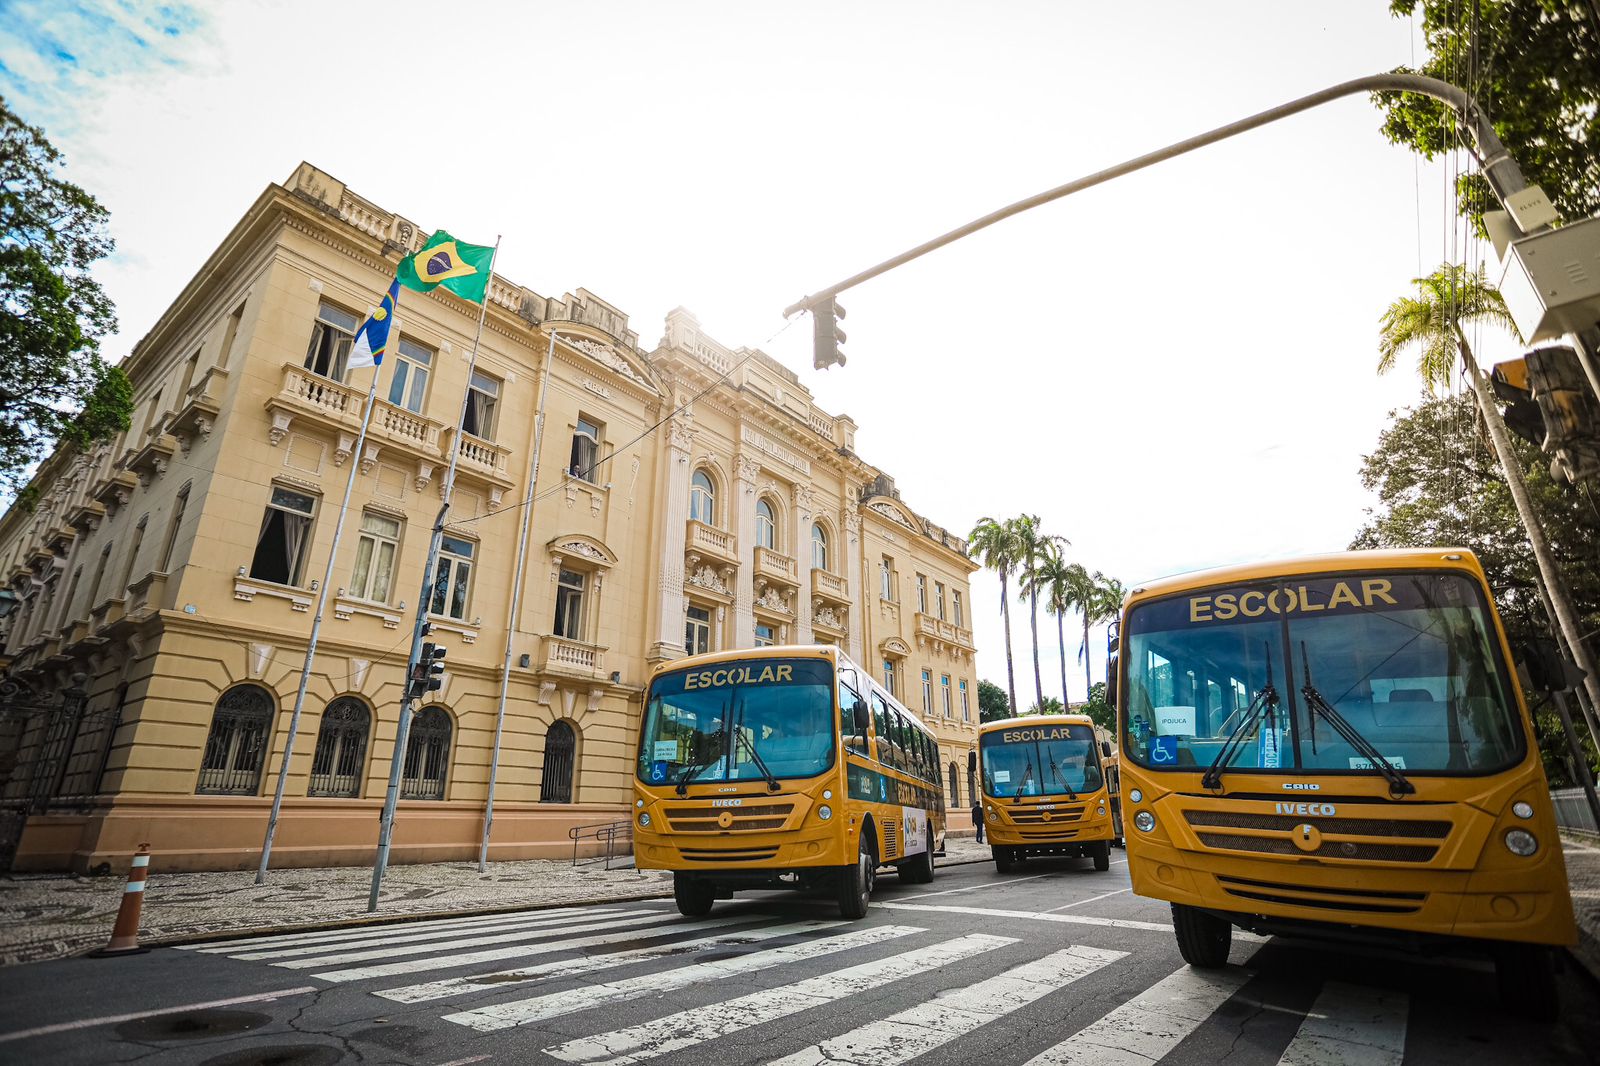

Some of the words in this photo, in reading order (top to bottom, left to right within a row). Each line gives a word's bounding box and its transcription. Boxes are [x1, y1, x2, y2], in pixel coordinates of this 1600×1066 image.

[1189, 578, 1398, 622] ESCOLAR
[684, 664, 793, 690] ESCOLAR
[1003, 728, 1071, 743] ESCOLAR
[712, 799, 742, 807] IVECO
[1275, 802, 1336, 817] IVECO
